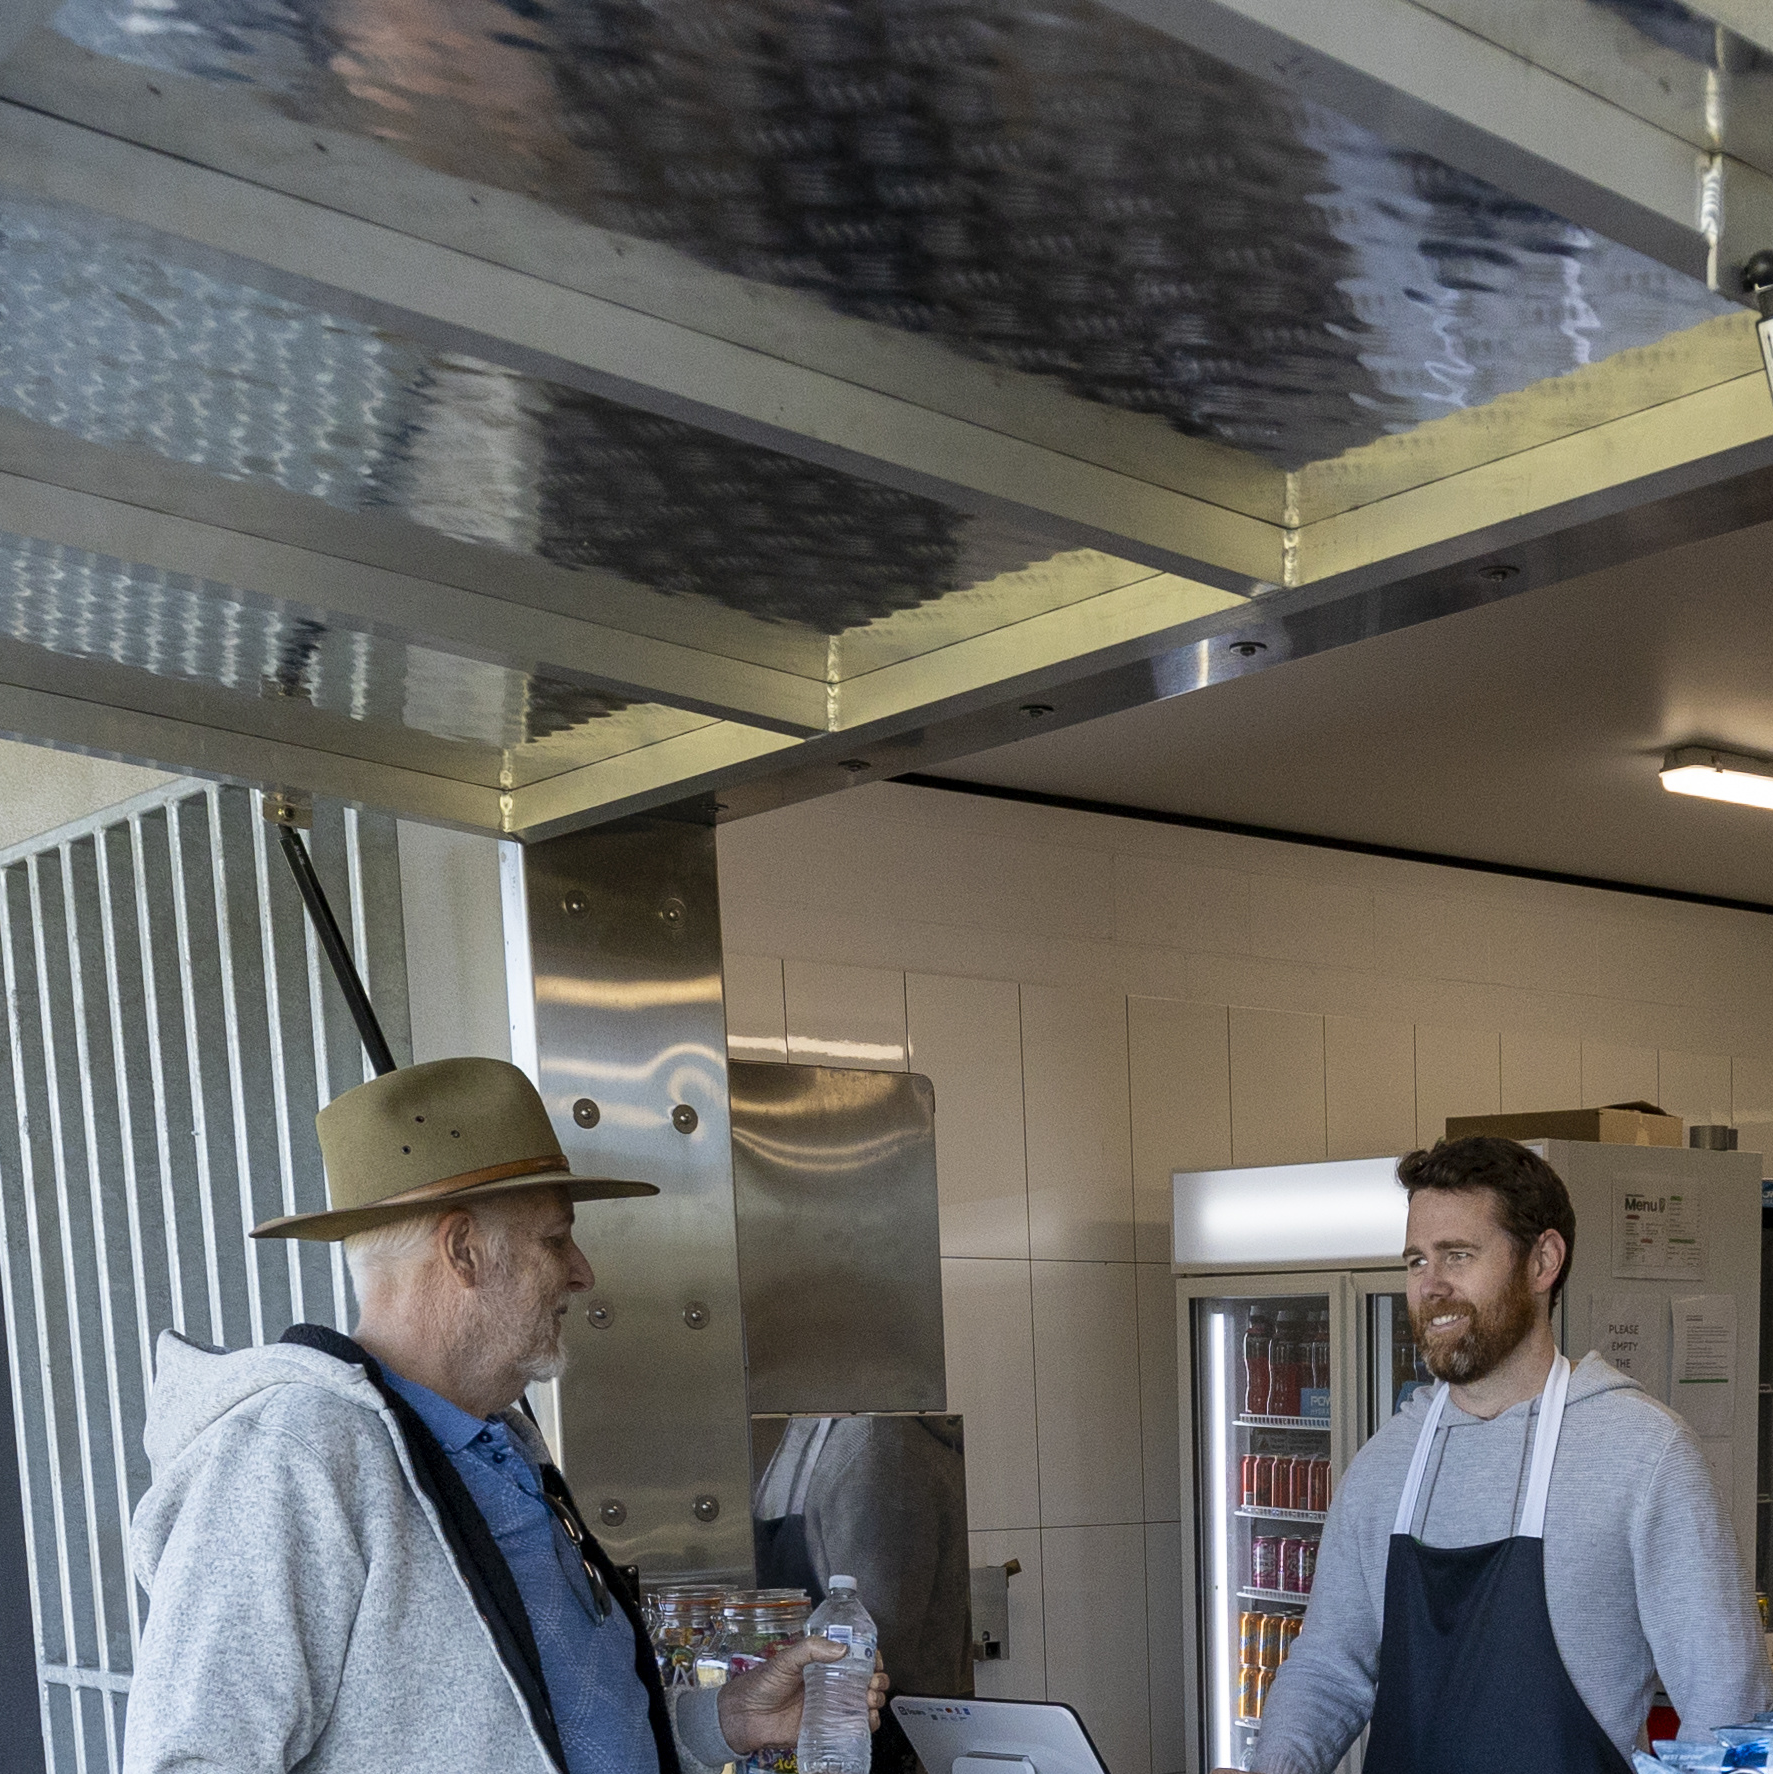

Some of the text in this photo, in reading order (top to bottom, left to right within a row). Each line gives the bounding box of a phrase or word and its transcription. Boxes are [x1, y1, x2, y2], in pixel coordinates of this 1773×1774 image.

[1625, 1198, 1658, 1212] Menu
[1609, 1325, 1639, 1335] PLEASE
[1612, 1342, 1638, 1351] EMPTY
[1615, 1359, 1631, 1368] THE
